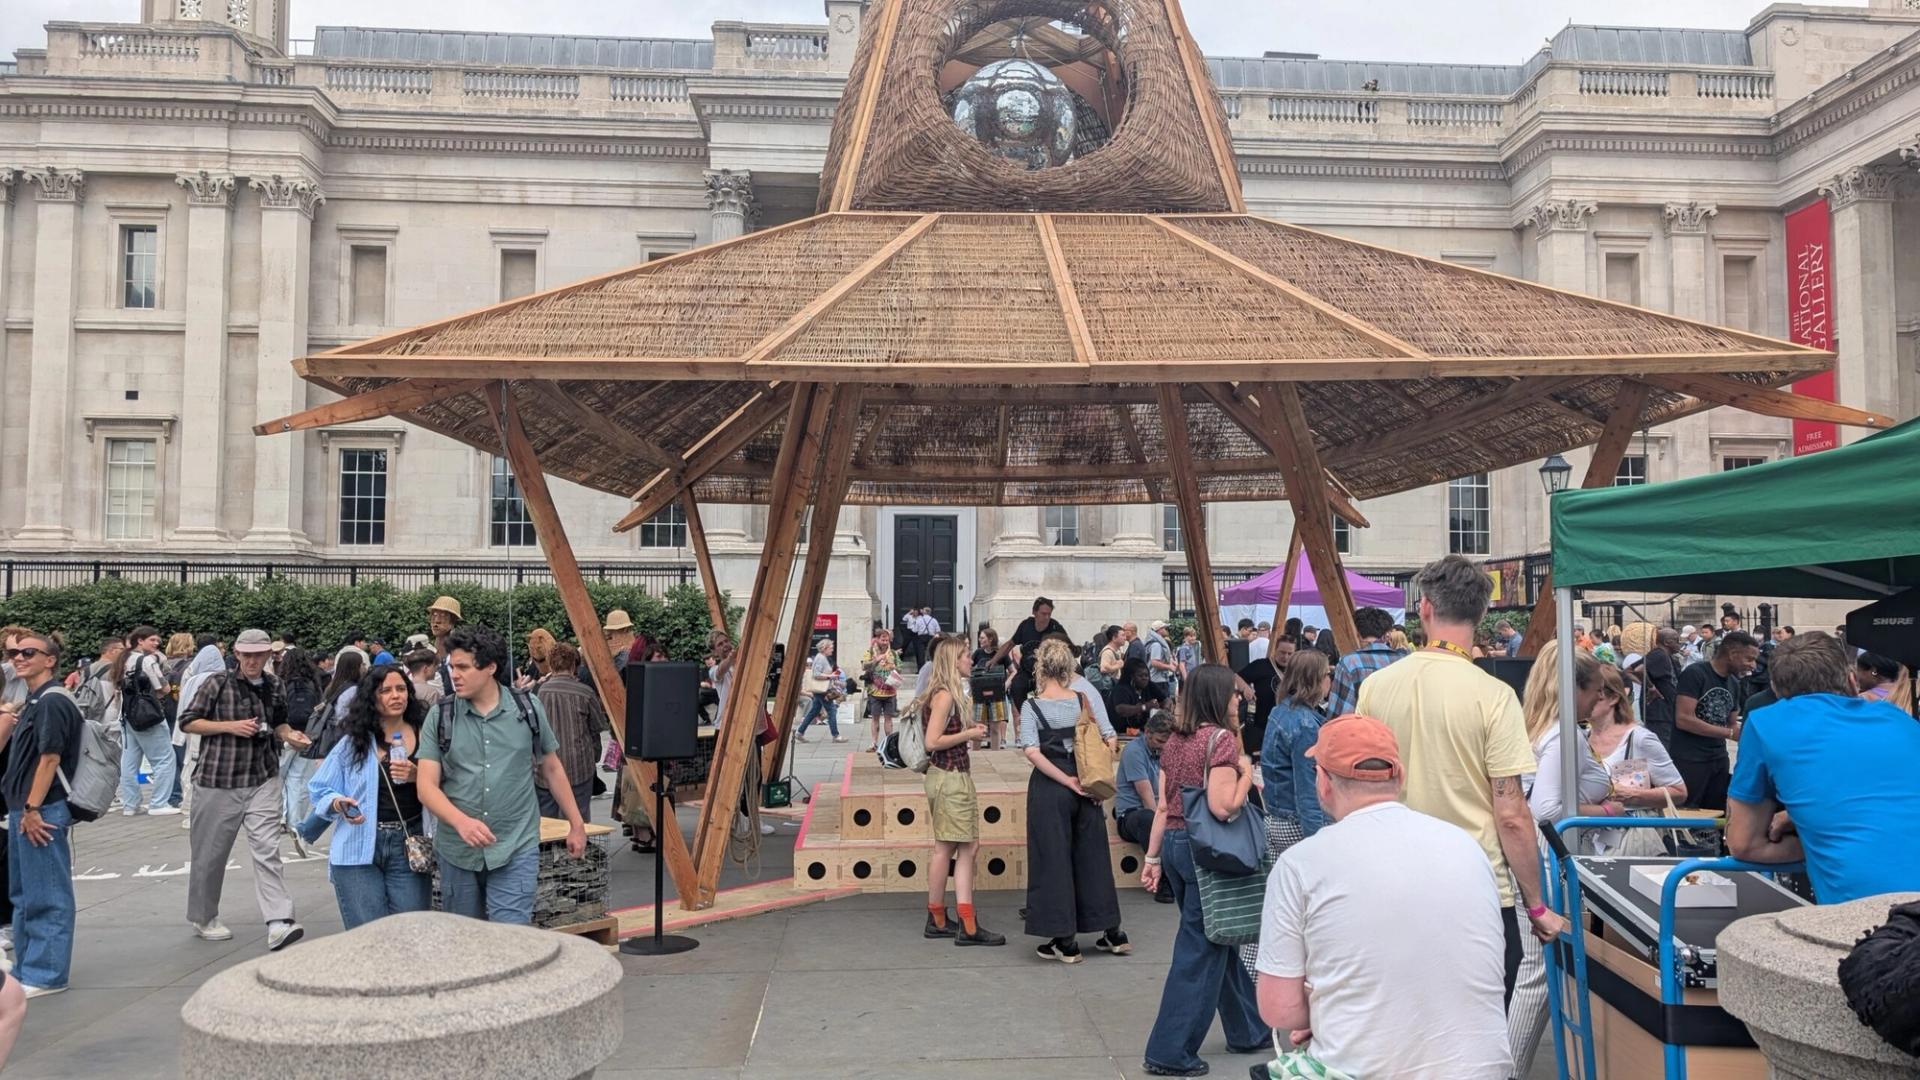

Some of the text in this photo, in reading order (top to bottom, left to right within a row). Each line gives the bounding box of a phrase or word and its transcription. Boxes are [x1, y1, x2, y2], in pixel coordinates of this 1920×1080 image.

[1810, 243, 1826, 351] GALLERY
[1806, 431, 1822, 441] FREE
[1797, 440, 1833, 454] ADMISSION
[1872, 617, 1914, 625] SHURE
